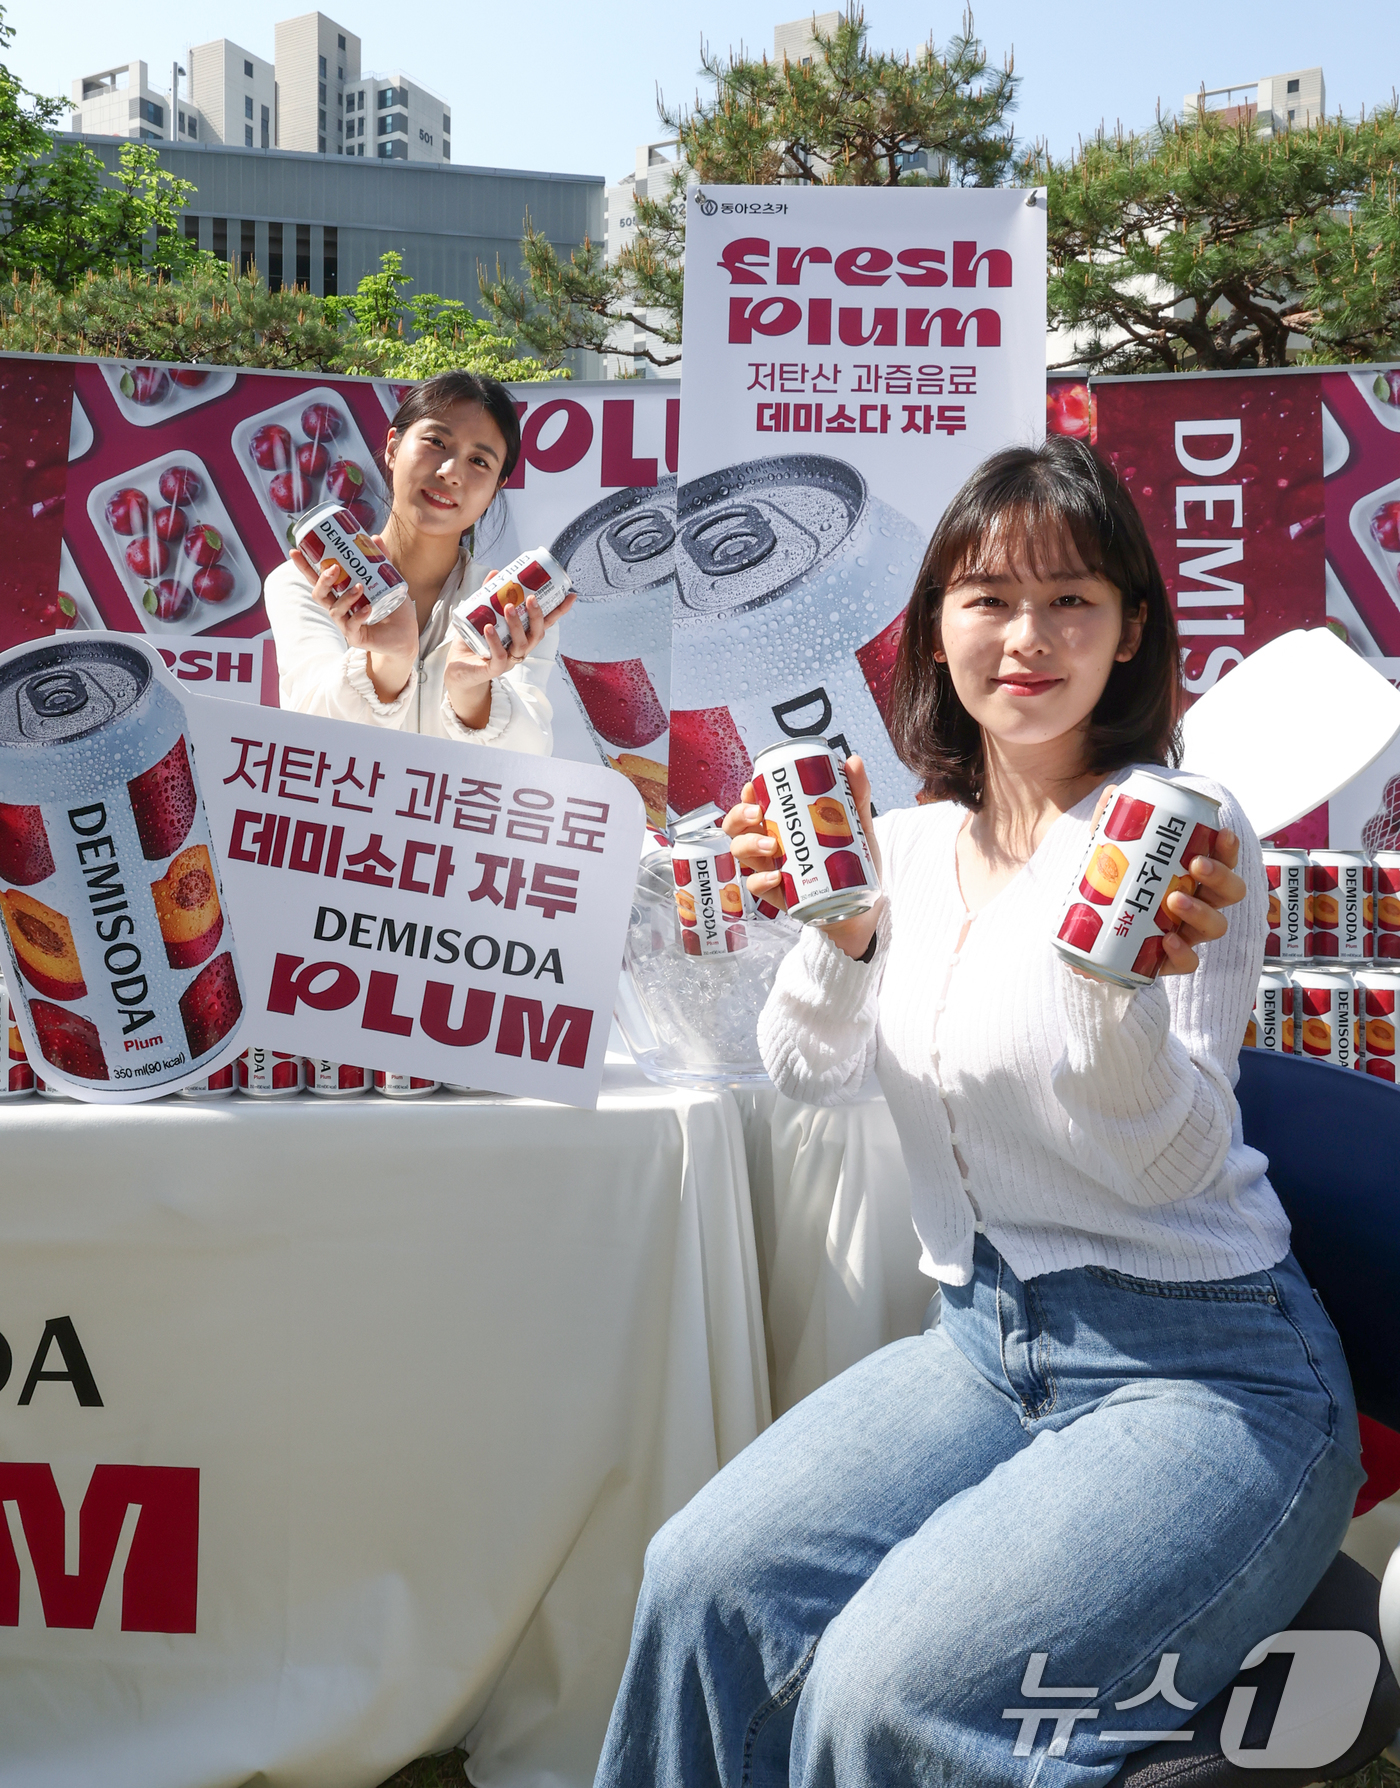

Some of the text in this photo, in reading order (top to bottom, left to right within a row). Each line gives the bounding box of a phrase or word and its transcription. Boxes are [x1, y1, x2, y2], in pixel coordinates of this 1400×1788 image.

[419, 128, 433, 146] 501
[721, 202, 788, 215] 동아오츠카
[717, 237, 1012, 287] fresh
[728, 297, 1001, 347] plum
[747, 363, 977, 395] 저탄산 과즙음료
[501, 398, 680, 489] PL
[756, 402, 966, 435] 데미소다 자두
[320, 520, 373, 586] DEMISODA
[1174, 418, 1245, 694] DEMIS
[223, 737, 610, 853] 저탄산 과즙음료
[772, 767, 814, 876] DEMISODA
[228, 809, 580, 919] 데미소다 자두
[802, 876, 818, 885] Plum
[1125, 817, 1186, 913] 데미소다
[68, 802, 156, 1035] DEMISODA
[696, 859, 718, 940] DEMISODA
[1114, 911, 1135, 937] 자두
[1288, 868, 1299, 942] DEMISODA
[1346, 868, 1357, 942] DEMISODA
[313, 906, 564, 984] DEMISODA
[124, 1035, 163, 1052] Plum
[266, 953, 594, 1069] PLUM
[1264, 990, 1276, 1050] DEMISO
[114, 1069, 133, 1079] 350
[253, 1047, 265, 1073] DA
[0, 1316, 104, 1407] A
